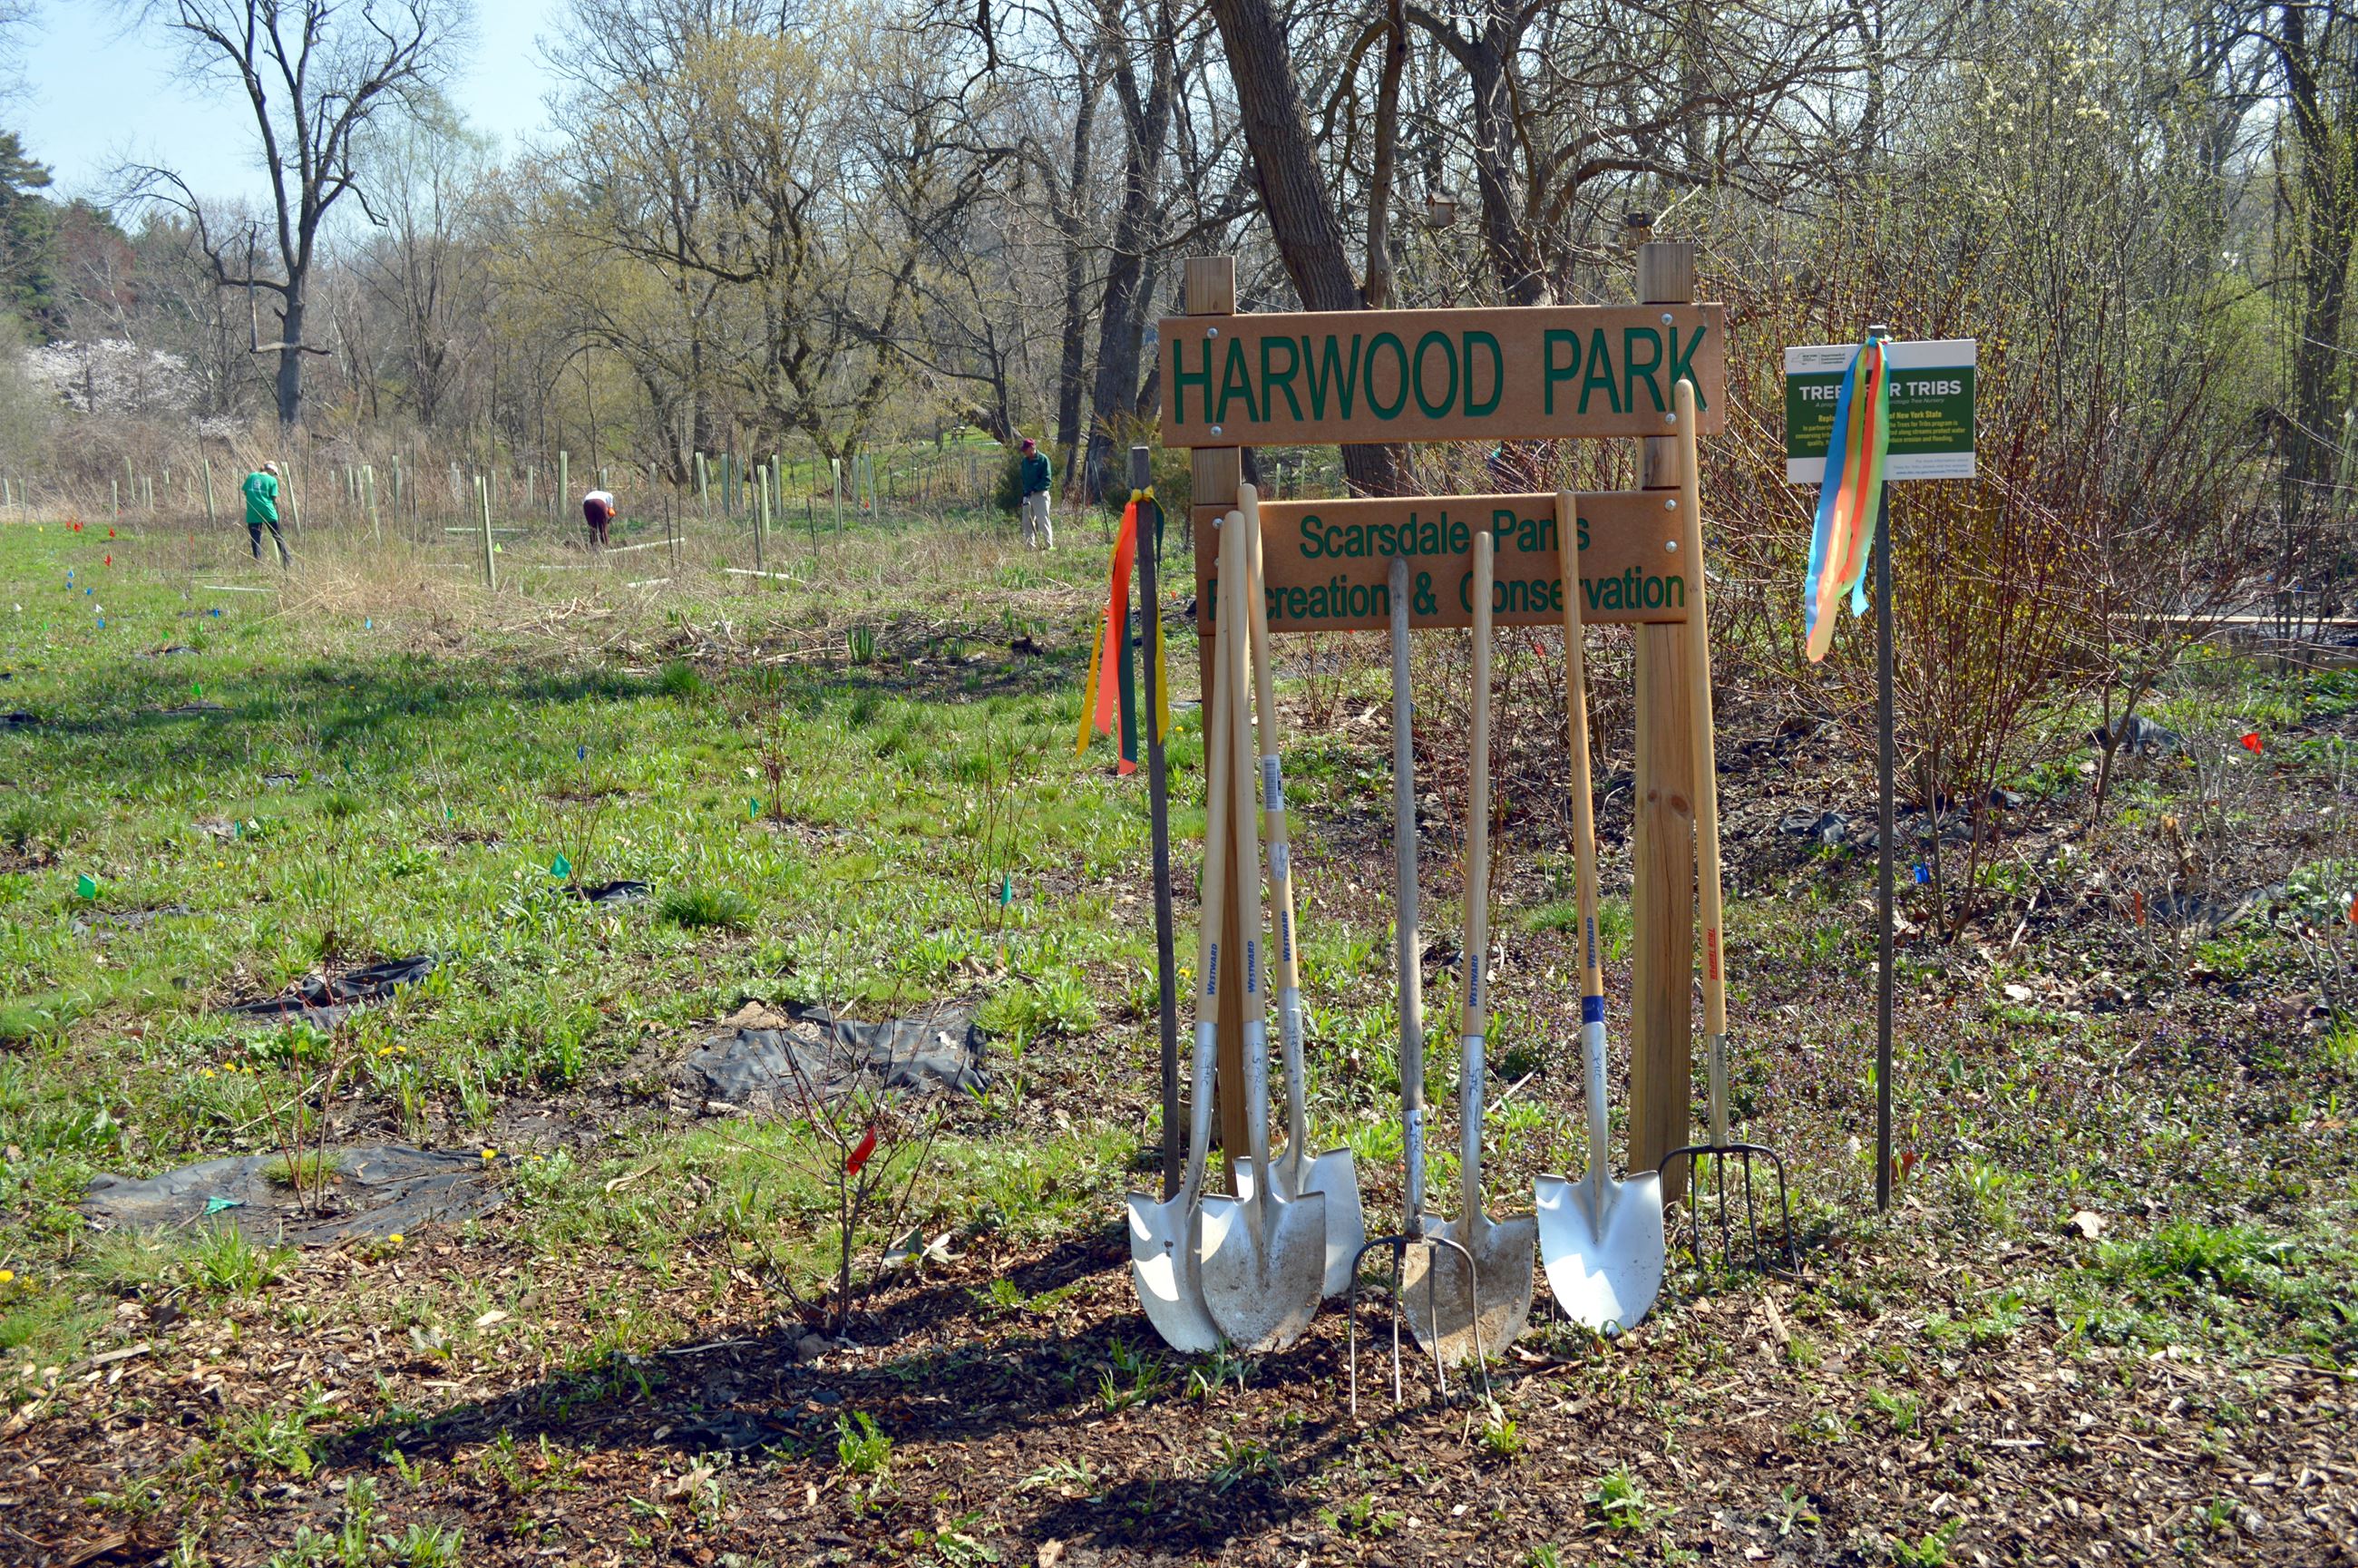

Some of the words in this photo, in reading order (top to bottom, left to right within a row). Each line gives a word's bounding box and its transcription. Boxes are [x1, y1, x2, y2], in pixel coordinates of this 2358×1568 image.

[1173, 329, 1505, 425] HARWOOD
[1544, 326, 1708, 415] PARK
[1798, 385, 1843, 401] TREE
[1865, 382, 1902, 398] FR
[1906, 380, 1962, 396] TRIBS
[1895, 411, 1910, 419] New
[1910, 410, 1924, 419] York
[1924, 409, 1943, 419] State
[1300, 511, 1470, 559] Scarsdale
[1207, 574, 1391, 621] creation
[1412, 570, 1439, 616] &
[1458, 565, 1685, 615] Consevation
[1281, 910, 1291, 962] WESTWARD
[1586, 916, 1596, 969] WESTWARD
[1707, 927, 1717, 948] TRUE
[1206, 942, 1218, 996] WESTWARD
[1247, 940, 1256, 994] WESTWARD
[1468, 954, 1479, 1008] WESTWARD
[1708, 950, 1718, 981] TEMPER
